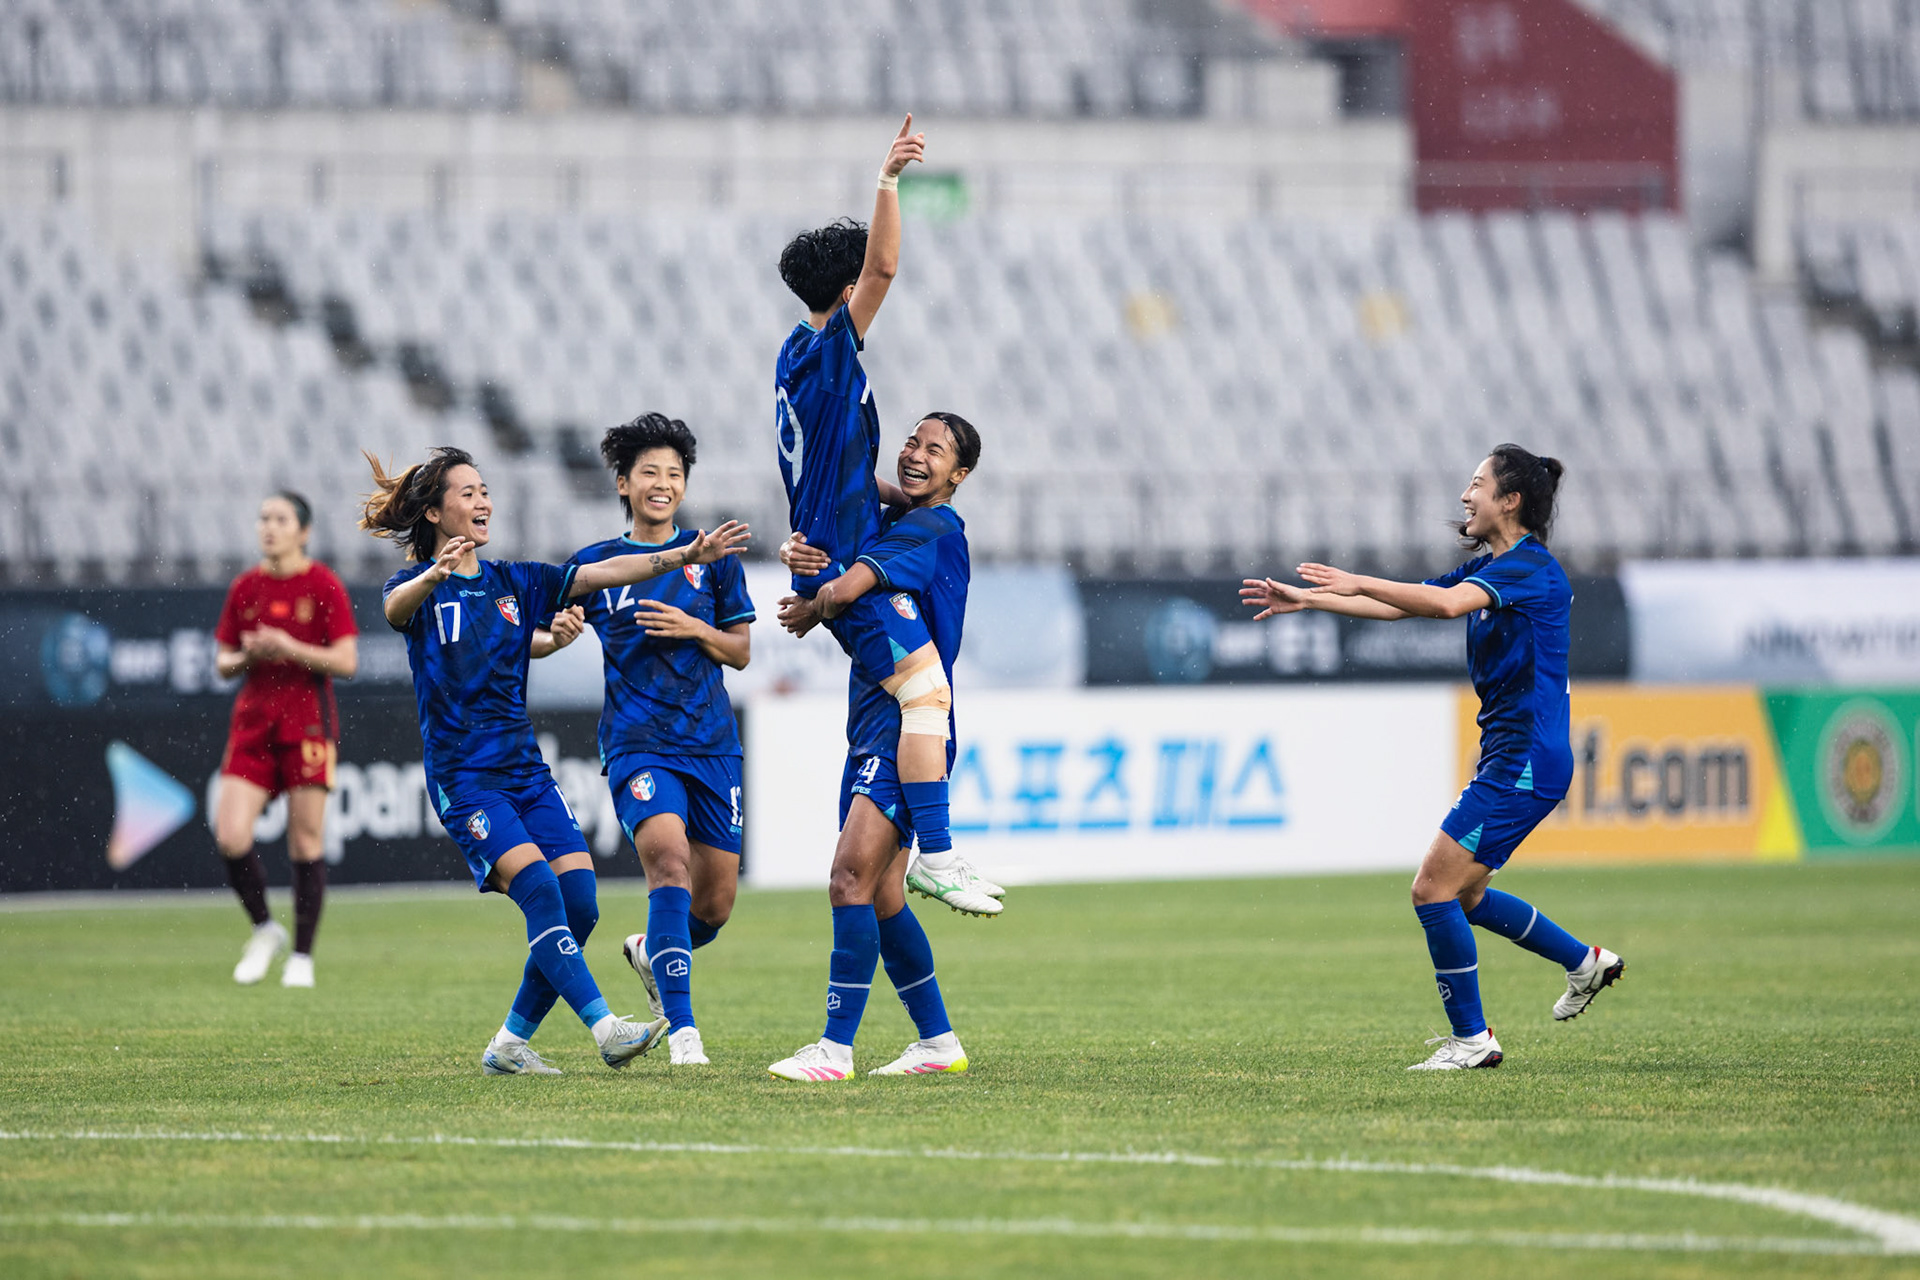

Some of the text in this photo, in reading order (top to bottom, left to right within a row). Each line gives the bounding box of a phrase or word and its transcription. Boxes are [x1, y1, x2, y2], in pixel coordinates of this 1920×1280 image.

[434, 601, 461, 645] 17
[949, 738, 1284, 832] 스포츠 패스
